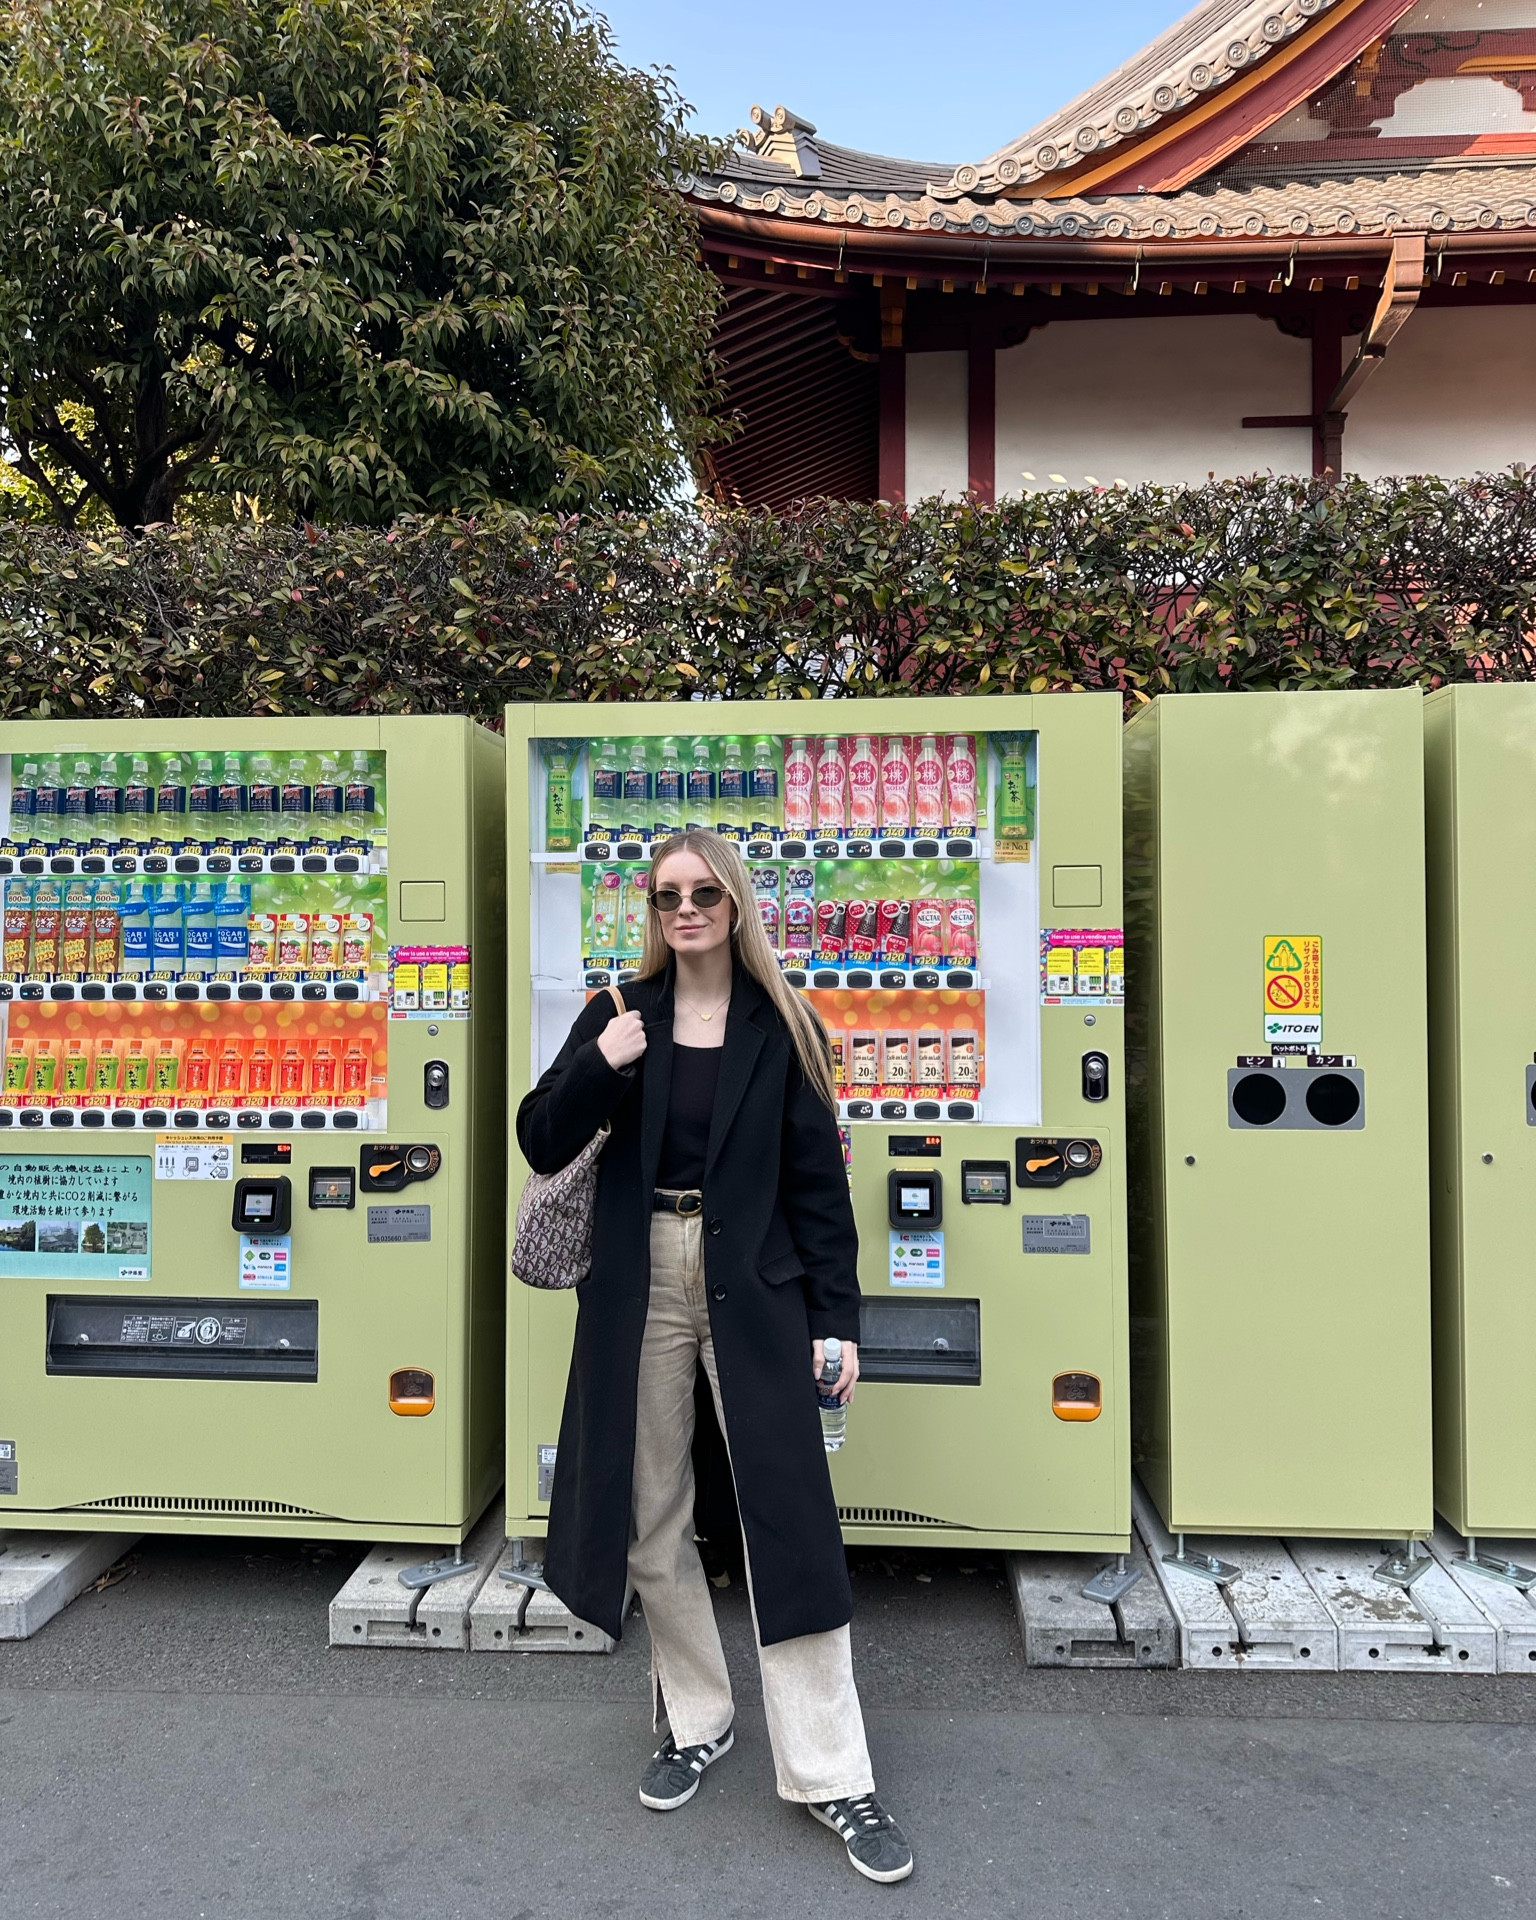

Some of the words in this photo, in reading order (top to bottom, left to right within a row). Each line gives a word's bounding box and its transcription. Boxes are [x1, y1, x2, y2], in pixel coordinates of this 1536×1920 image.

[792, 770, 805, 782] 桃
[824, 770, 838, 782] 桃
[856, 770, 870, 782] 桃
[890, 769, 903, 782] 桃
[921, 769, 936, 781] 桃
[956, 767, 970, 781] 桃
[1012, 842, 1028, 850] No.1
[1282, 1025, 1303, 1033] ITO
[1303, 1025, 1319, 1033] EN
[1316, 1056, 1335, 1064] カン
[858, 1067, 869, 1077] 20
[892, 1066, 903, 1076] 20
[924, 1066, 936, 1076] 20
[958, 1066, 969, 1076] 20
[0, 1163, 142, 1174] の自動販売機収益により
[8, 1174, 119, 1187] 境内の植樹に協力しています
[12, 1205, 116, 1217] 環境活動を続けて参ります
